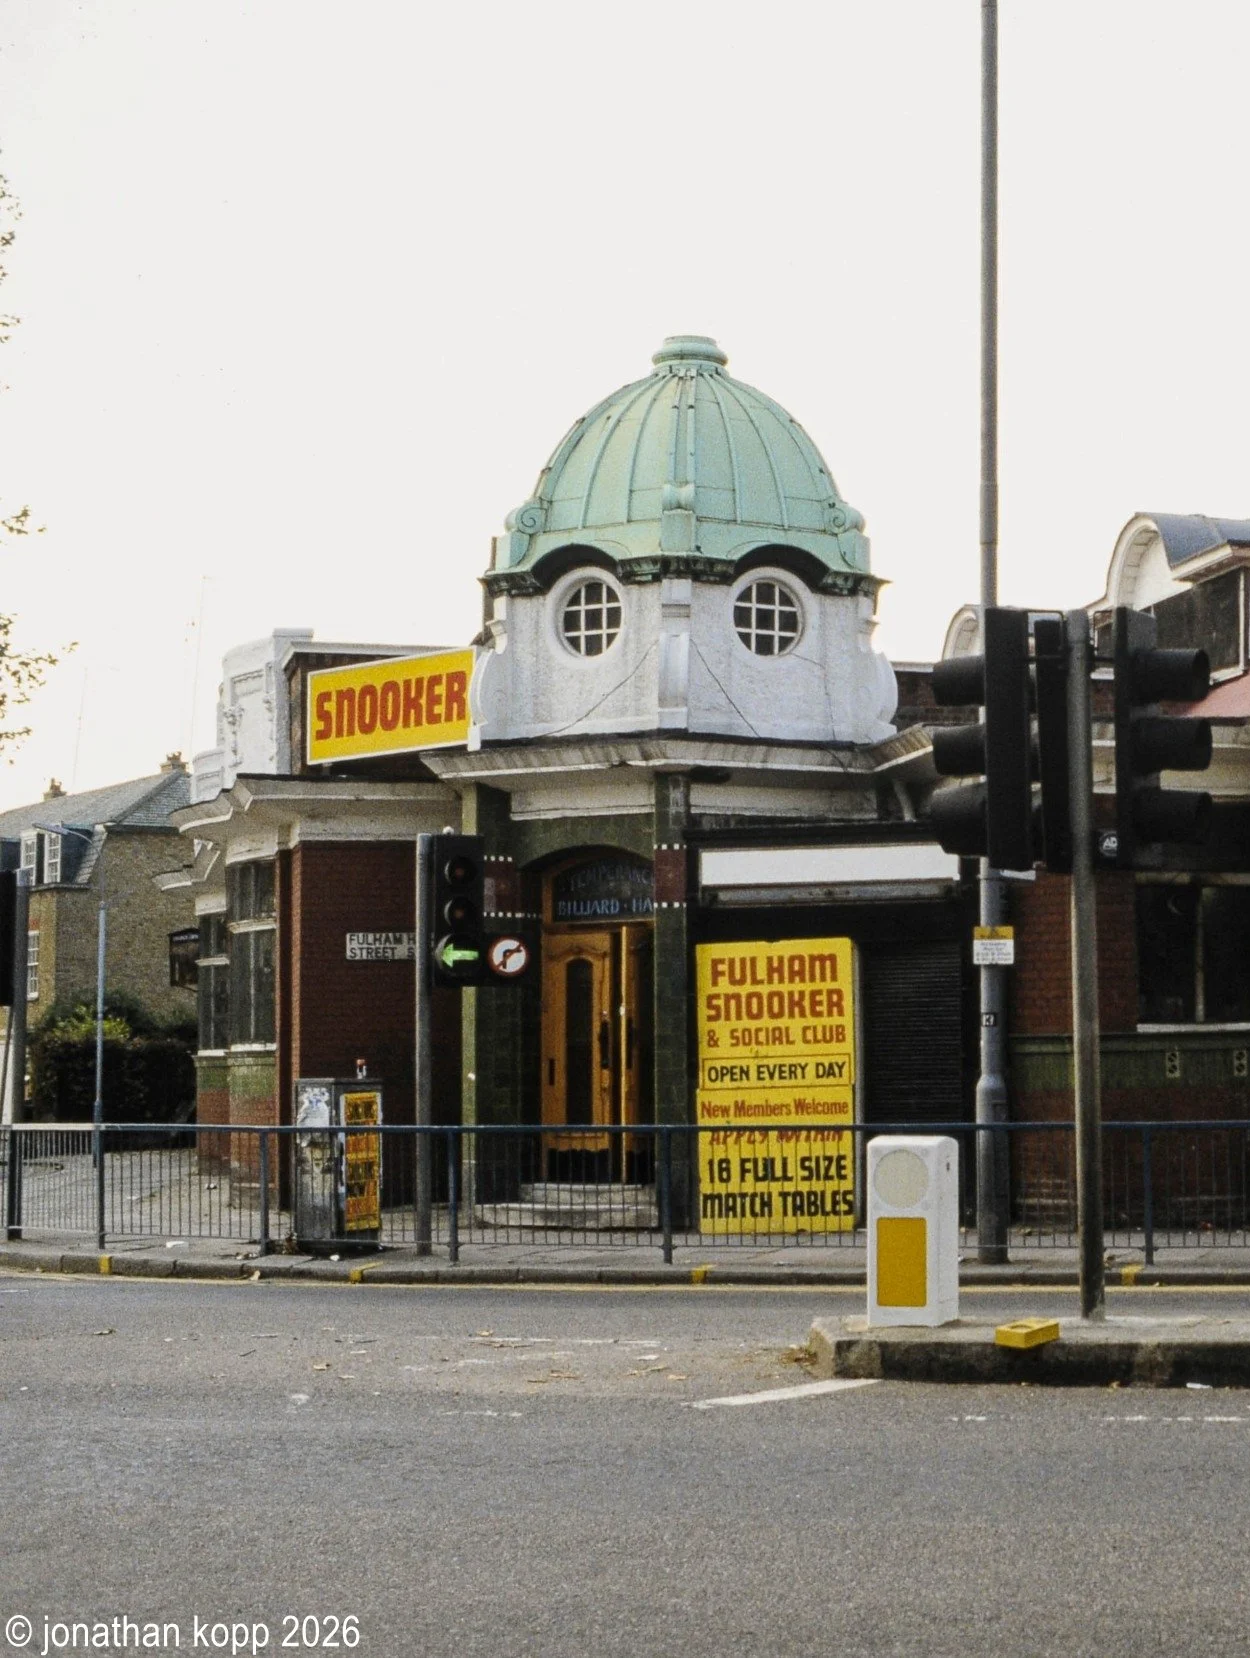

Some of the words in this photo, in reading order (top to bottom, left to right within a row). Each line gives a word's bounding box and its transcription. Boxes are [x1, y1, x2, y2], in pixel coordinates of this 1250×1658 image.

[315, 670, 467, 741] SNOOKER
[632, 896, 653, 913] HA
[350, 934, 401, 945] FULHAM
[350, 947, 396, 959] STREET
[710, 953, 838, 987] FULHAM
[706, 988, 845, 1022] SNOOKER
[707, 1028, 720, 1048] &
[729, 1026, 796, 1047] SOCIAL
[802, 1024, 846, 1044] CLUB
[707, 1065, 750, 1083] OPEN
[756, 1062, 809, 1081] EVERY
[815, 1061, 847, 1079] DAY
[701, 1102, 731, 1119] New
[733, 1100, 792, 1118] Members
[794, 1098, 848, 1116] Welcome
[740, 1157, 794, 1183] FULL
[800, 1155, 848, 1181] SIZE
[701, 1191, 773, 1219] MATCH
[777, 1189, 855, 1217] TABLES
